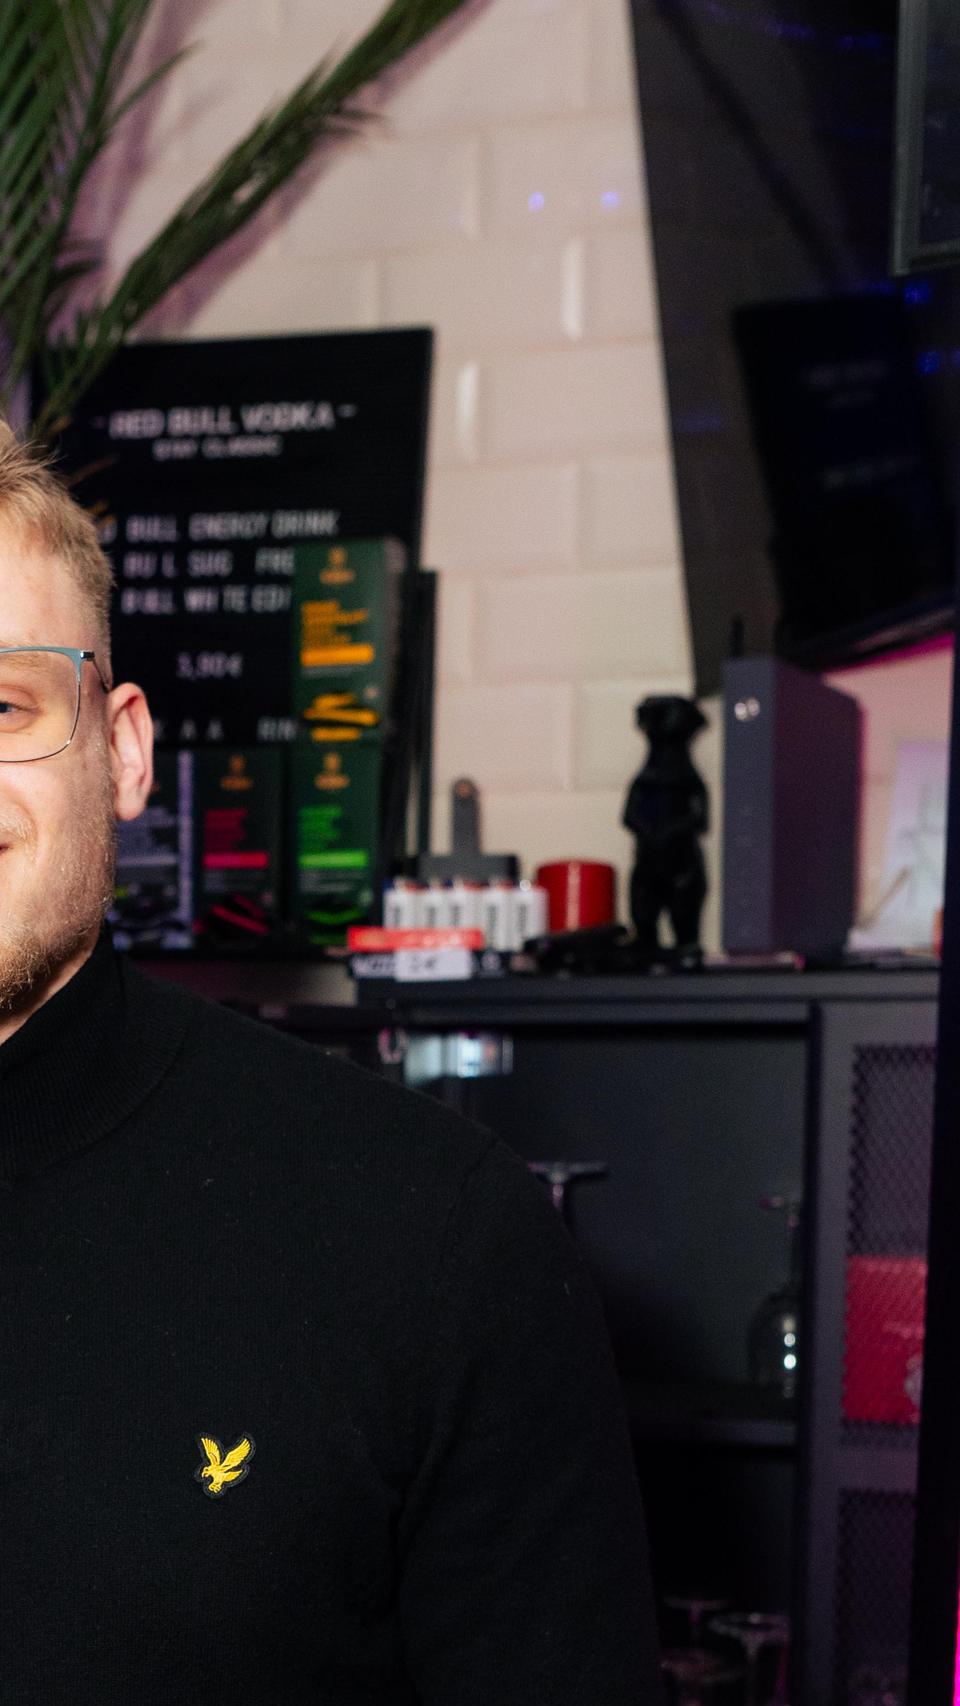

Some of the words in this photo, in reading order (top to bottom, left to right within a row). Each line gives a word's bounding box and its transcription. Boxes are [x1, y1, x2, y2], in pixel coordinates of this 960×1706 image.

[109, 408, 165, 439] RED
[167, 404, 238, 436] BULL
[240, 400, 336, 431] VODKA
[126, 514, 178, 543] BULL
[189, 511, 269, 541] ENERGY
[270, 509, 338, 539] DRINK
